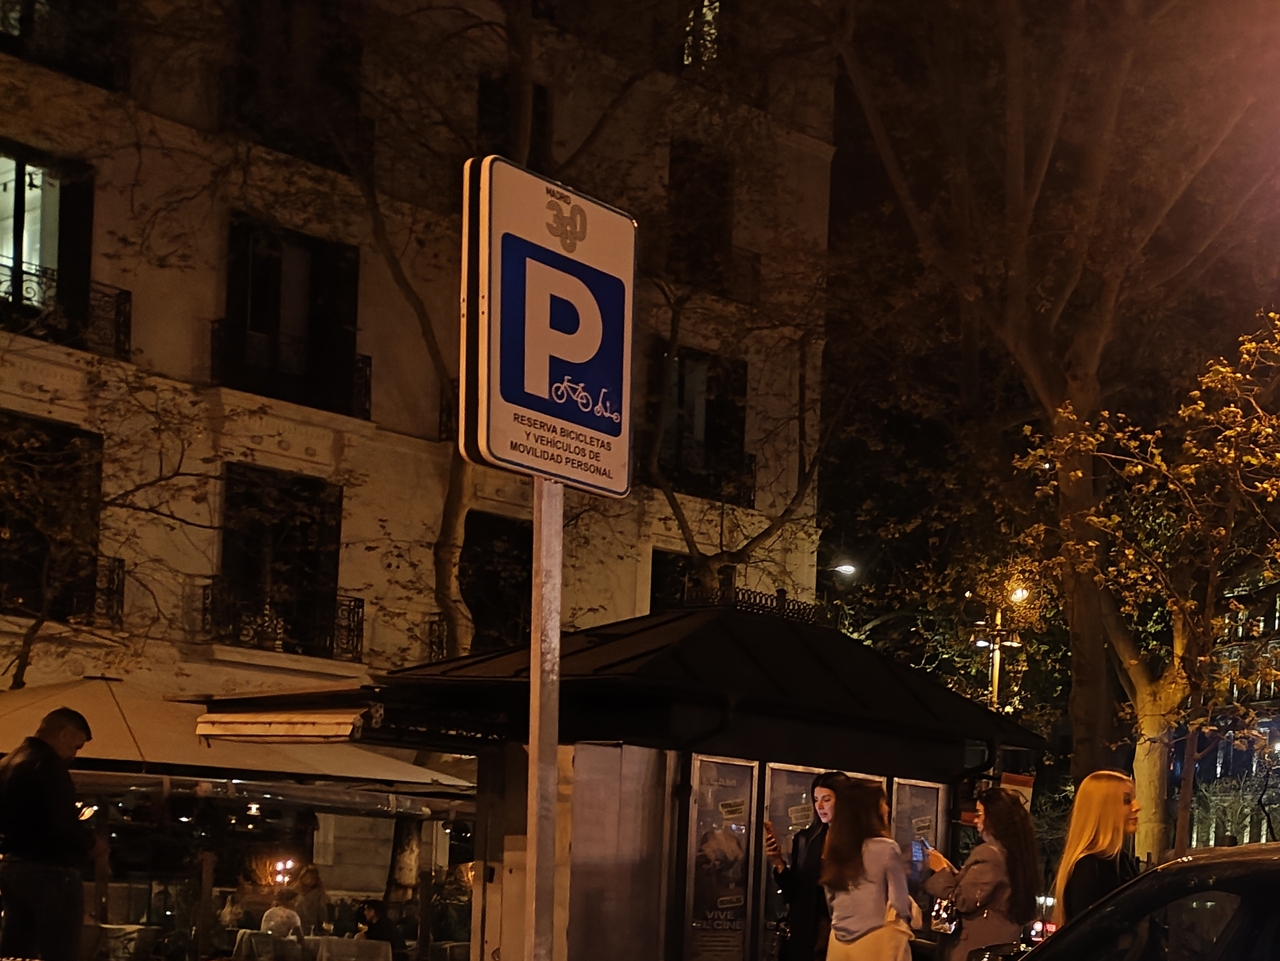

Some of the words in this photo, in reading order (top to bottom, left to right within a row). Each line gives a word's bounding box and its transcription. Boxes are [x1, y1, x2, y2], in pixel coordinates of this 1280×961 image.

[524, 256, 603, 400] P
[513, 413, 558, 435] RESERVA
[560, 427, 612, 451] BICICLETAS
[524, 431, 532, 441] Y
[533, 433, 586, 458] VEHÍCULOS
[588, 449, 602, 462] DE
[510, 440, 563, 464] MOVILIDAD
[564, 456, 614, 480] PERSONAL
